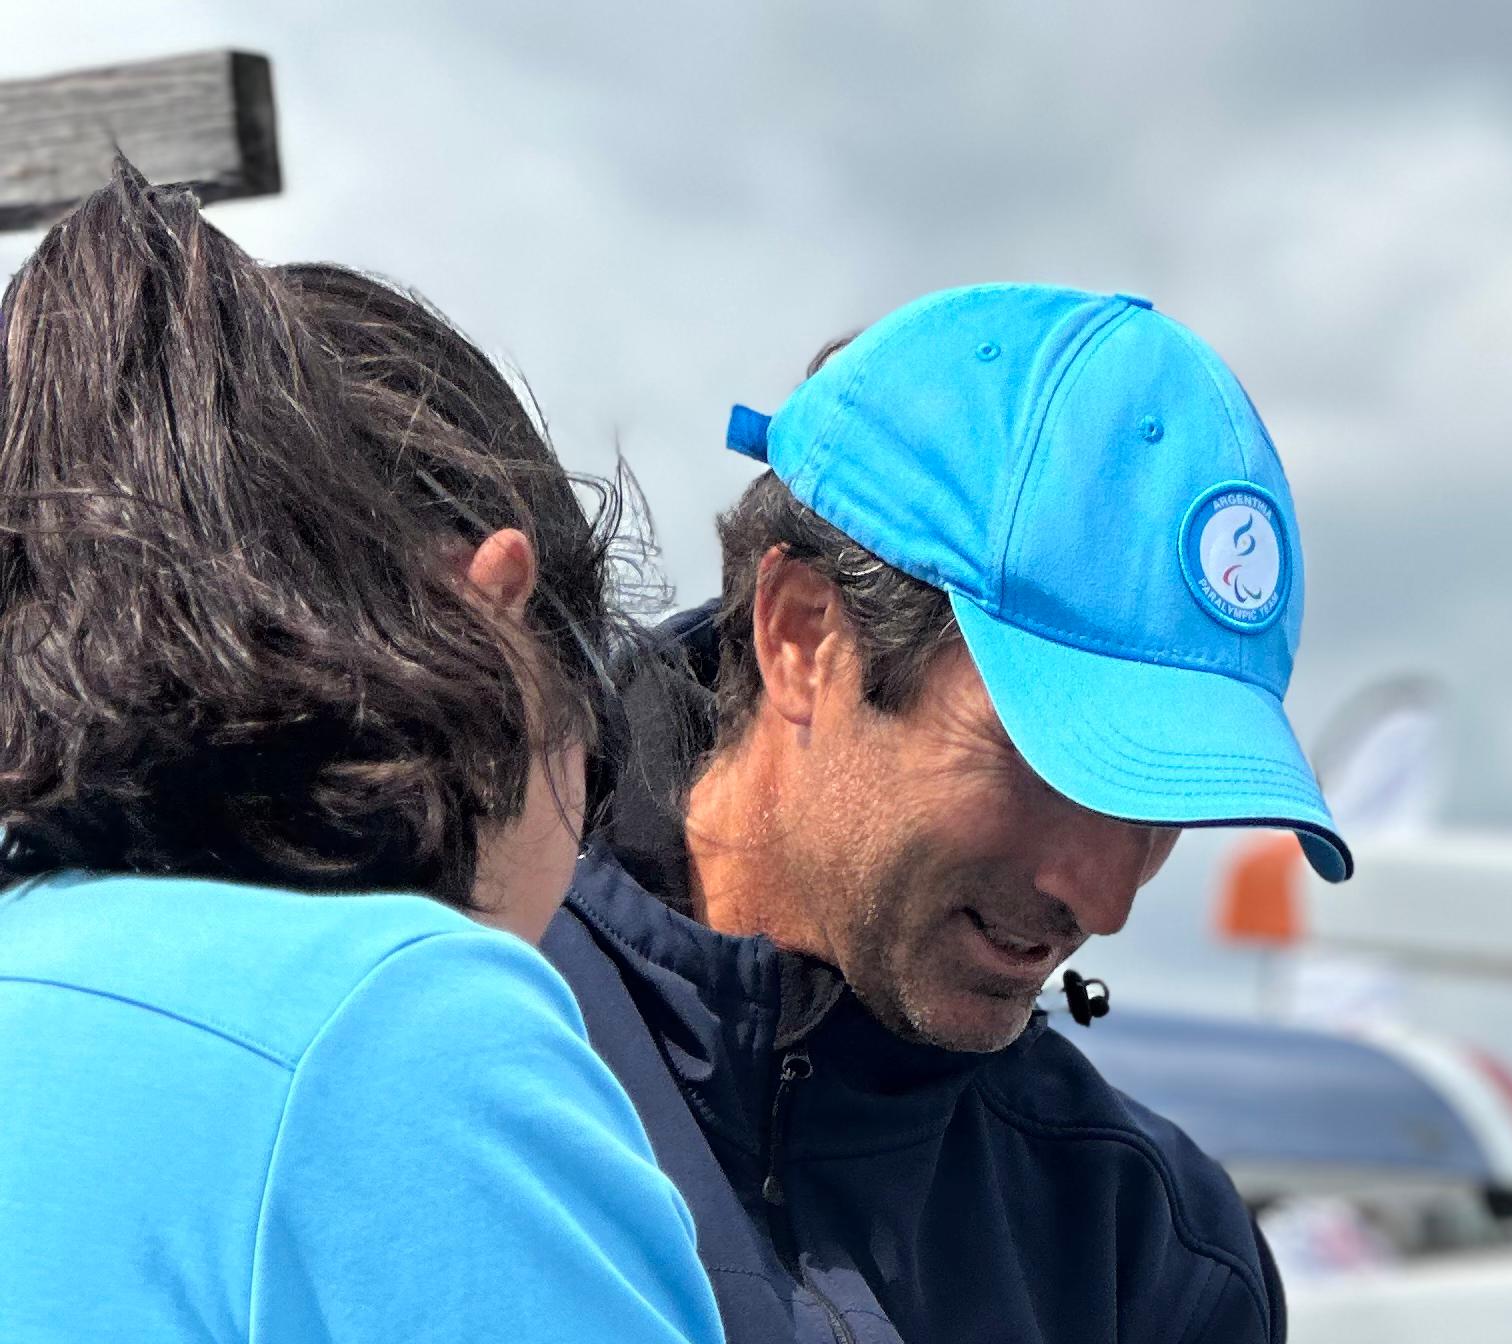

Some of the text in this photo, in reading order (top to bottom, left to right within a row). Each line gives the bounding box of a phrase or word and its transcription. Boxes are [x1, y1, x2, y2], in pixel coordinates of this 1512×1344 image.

[1213, 493, 1272, 521] ARGENTINA
[1199, 577, 1279, 621] PARALYMPIC TEAM
